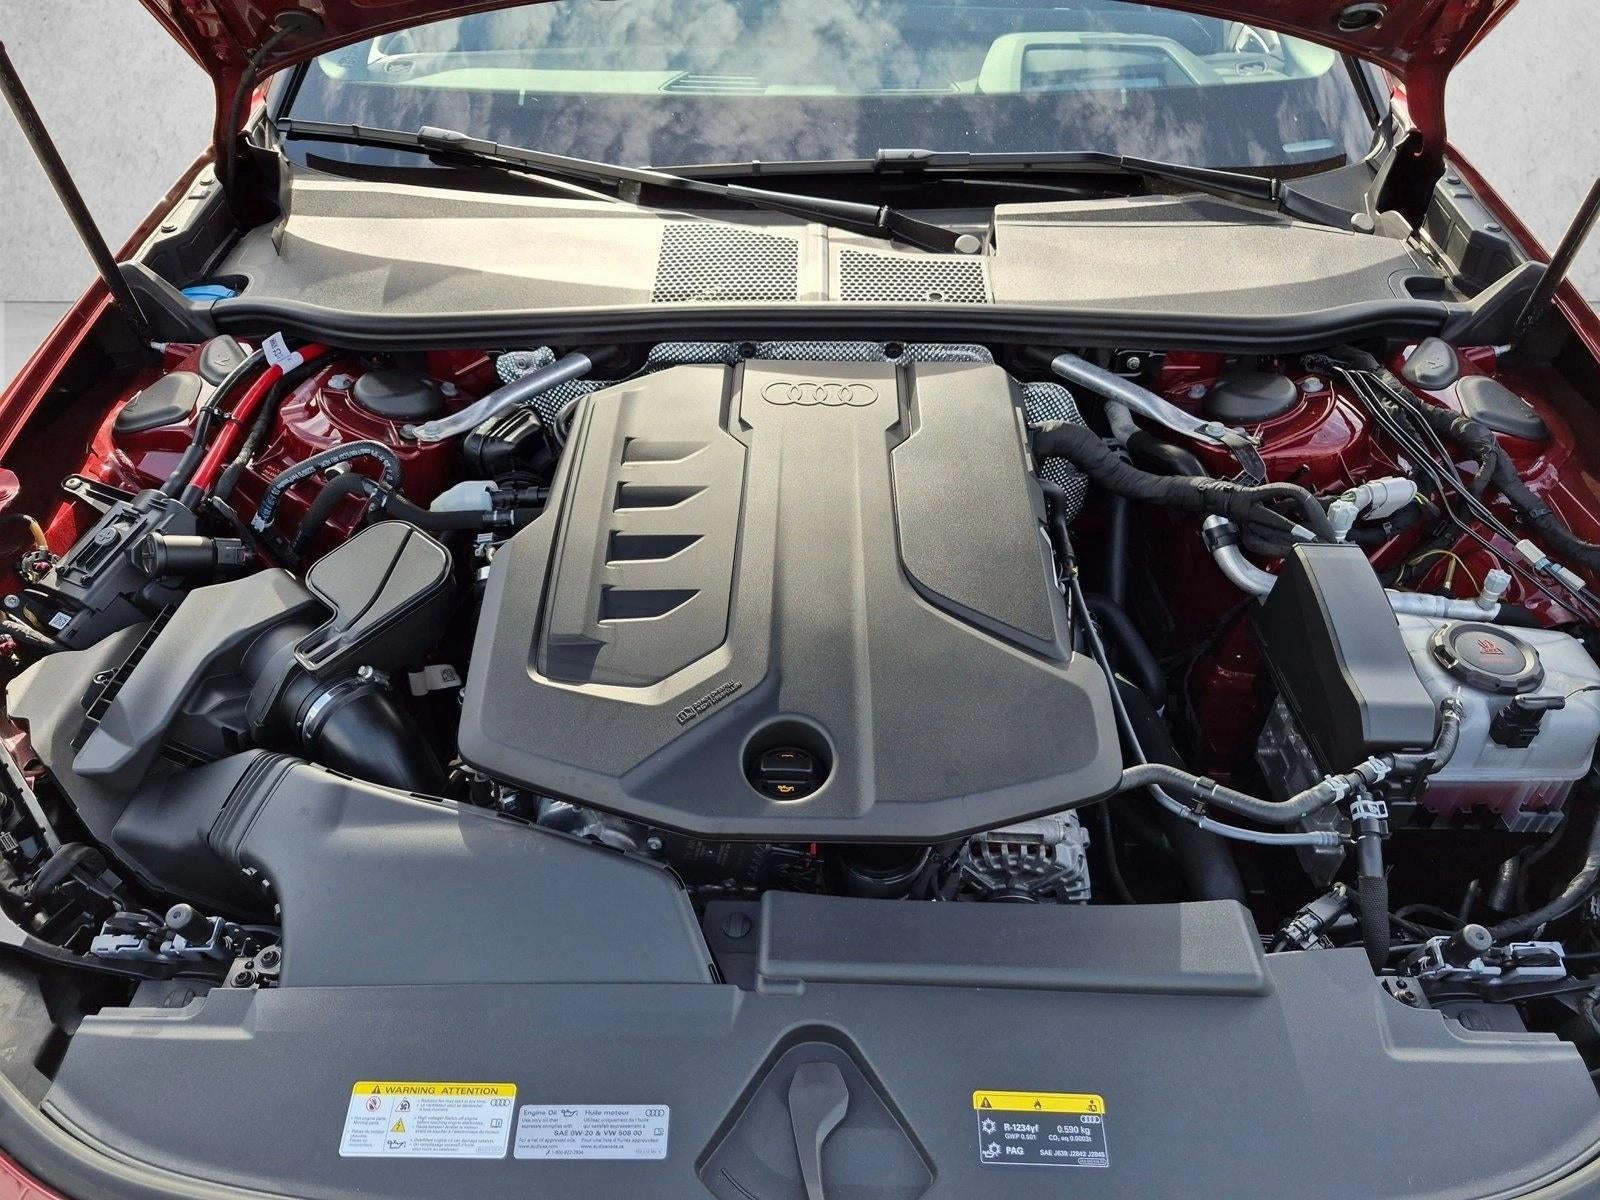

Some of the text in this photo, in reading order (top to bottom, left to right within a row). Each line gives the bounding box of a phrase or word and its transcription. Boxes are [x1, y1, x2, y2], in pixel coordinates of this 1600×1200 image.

[1004, 1124, 1039, 1133] R-1234yf
[1080, 1126, 1091, 1135] kg
[1006, 1147, 1024, 1155] PAG
